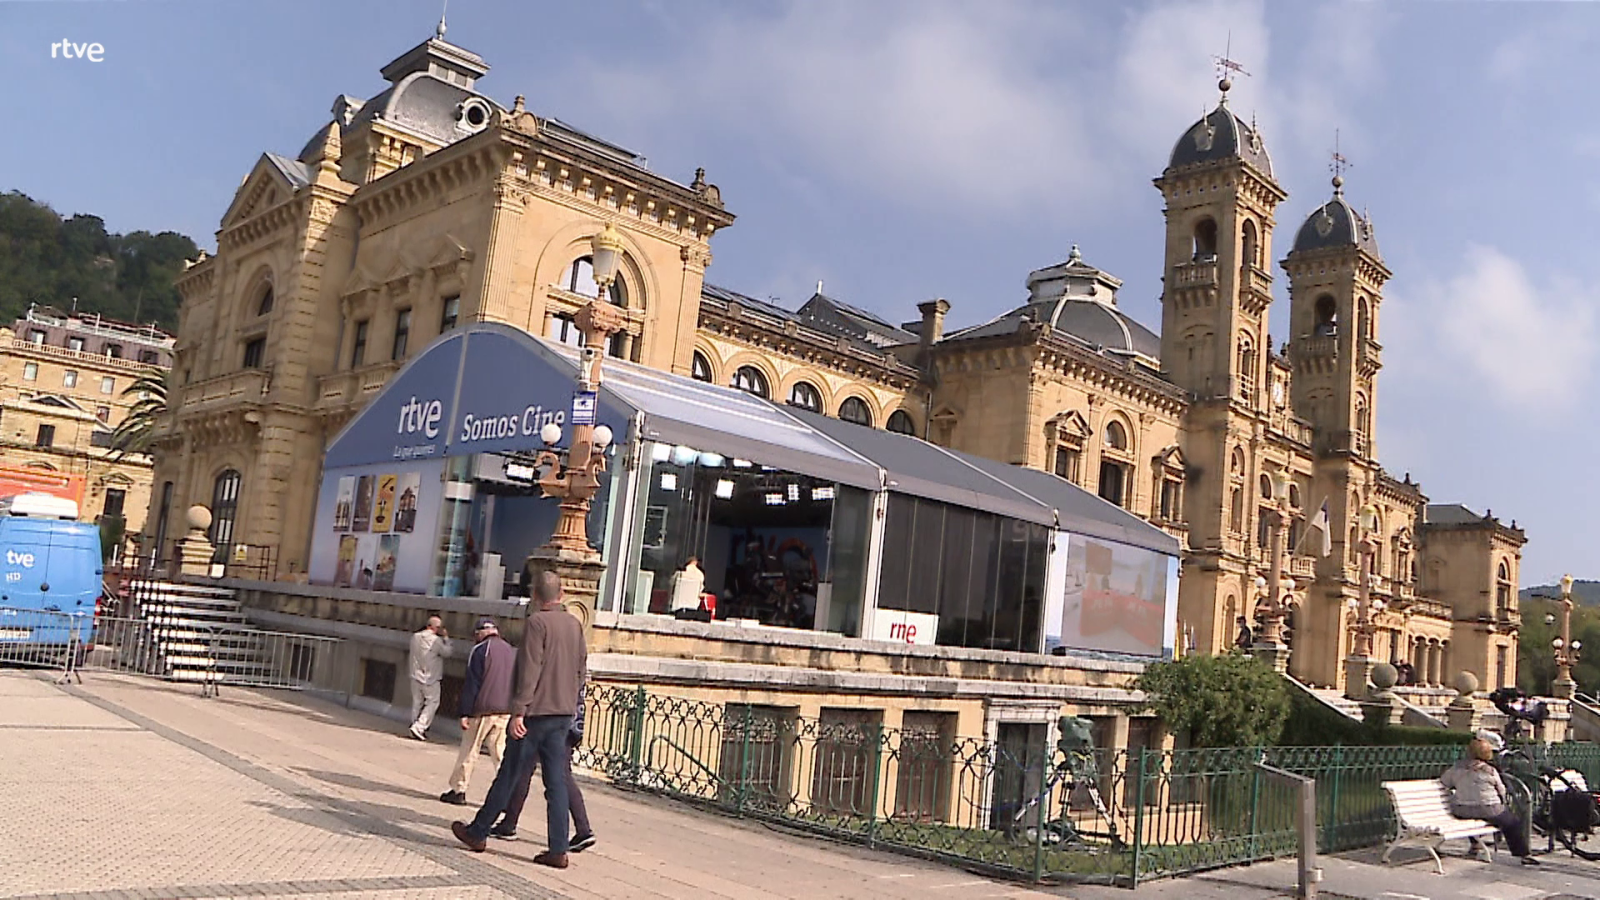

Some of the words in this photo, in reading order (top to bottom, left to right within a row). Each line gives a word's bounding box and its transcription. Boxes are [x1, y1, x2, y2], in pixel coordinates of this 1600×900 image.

[398, 396, 442, 438] rtve
[461, 413, 518, 442] Somos
[522, 405, 565, 437] Cine
[6, 549, 35, 568] tve
[6, 572, 21, 582] HD
[890, 622, 917, 644] rne
